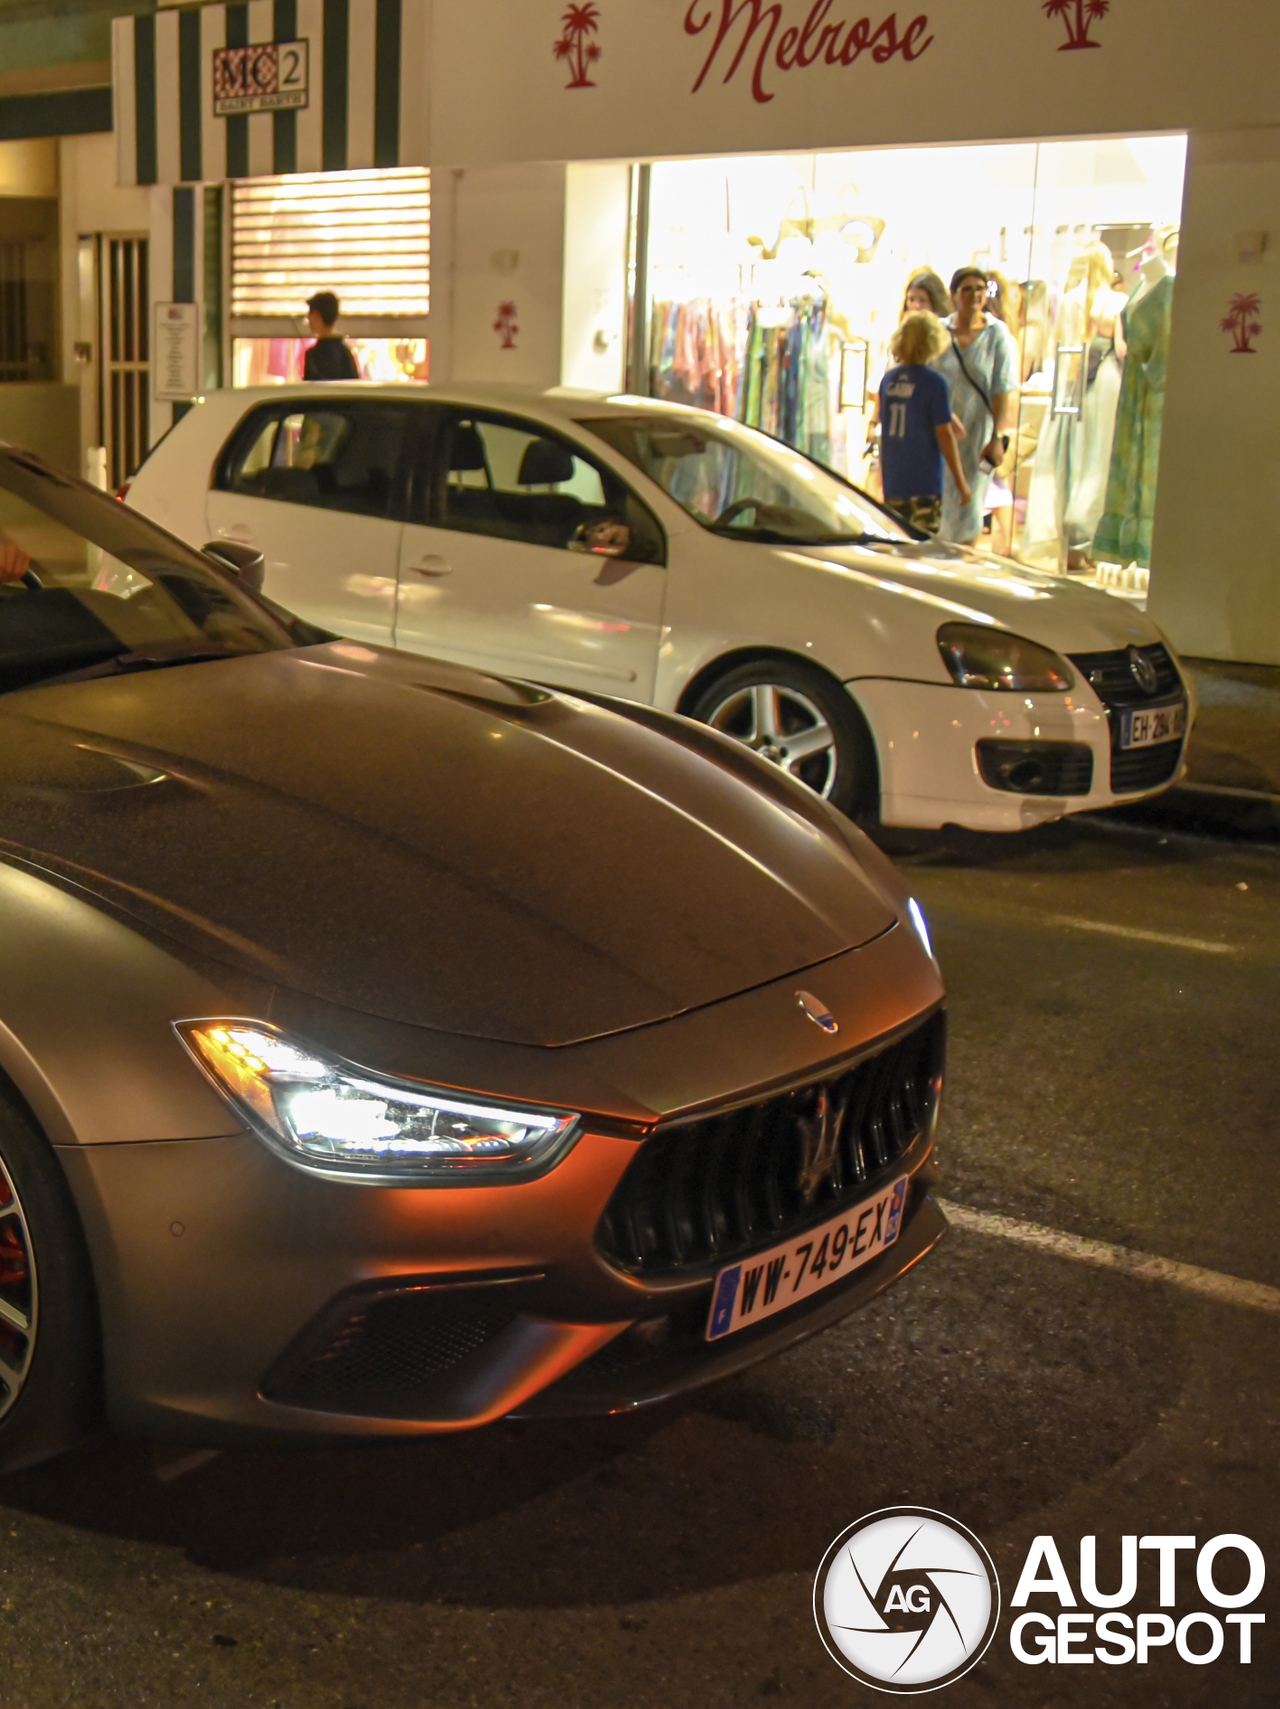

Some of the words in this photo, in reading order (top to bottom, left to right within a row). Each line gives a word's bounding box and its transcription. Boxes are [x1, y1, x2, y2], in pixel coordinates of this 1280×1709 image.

[684, 0, 935, 104] Melrose
[889, 402, 907, 437] 11
[740, 1197, 889, 1317] WW-749-EX
